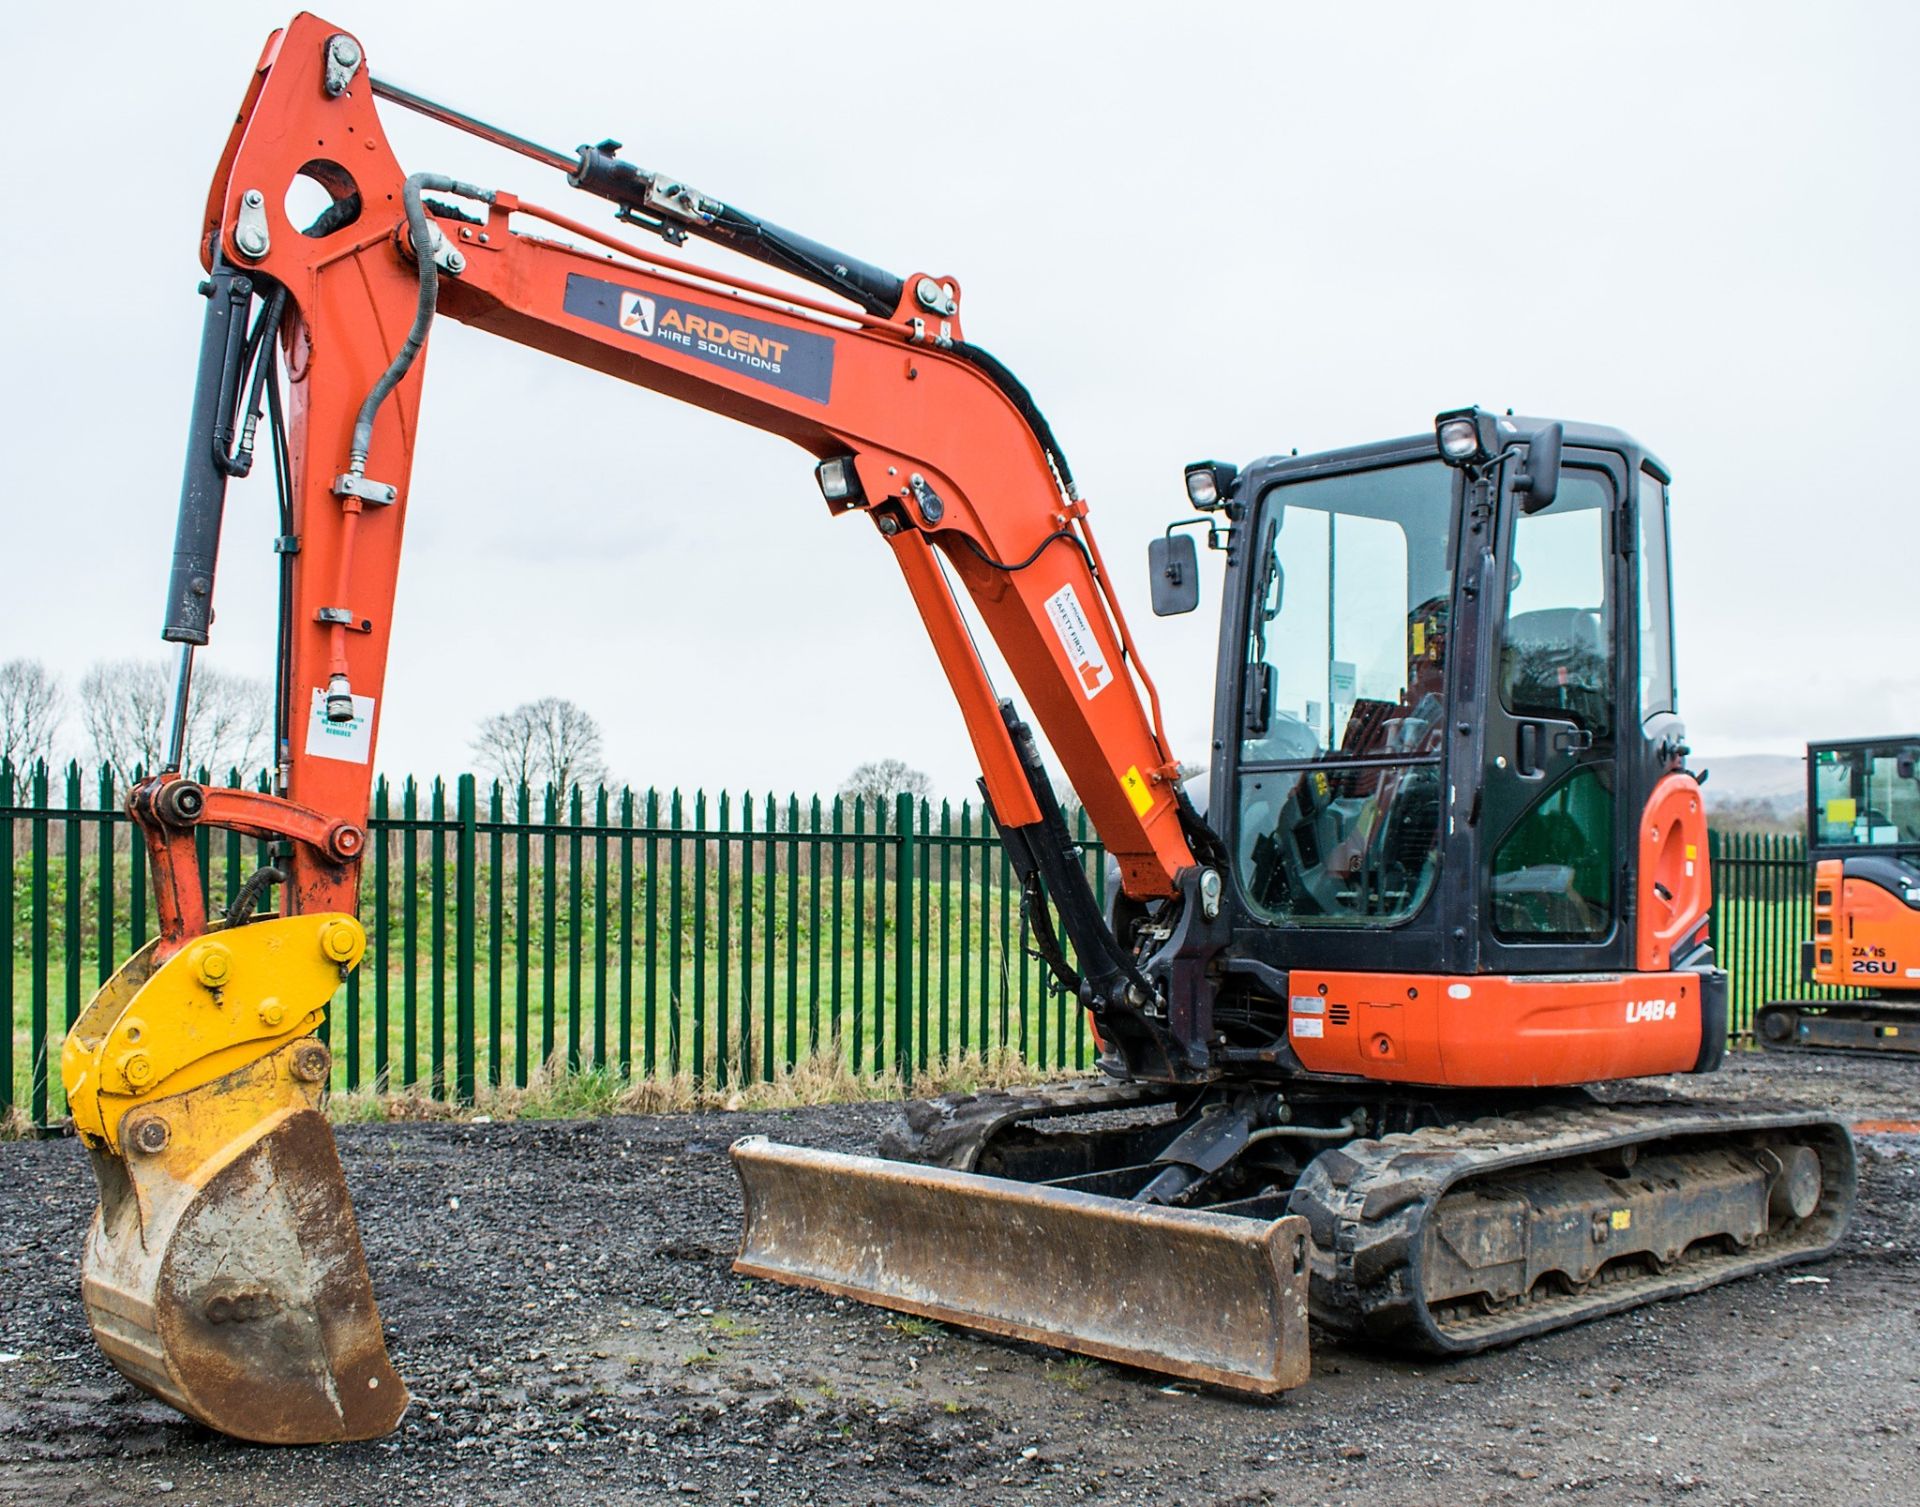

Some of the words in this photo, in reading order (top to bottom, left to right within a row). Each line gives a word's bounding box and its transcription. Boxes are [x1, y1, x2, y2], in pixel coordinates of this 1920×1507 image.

[657, 328, 691, 346] HIRE
[697, 340, 782, 374] SOLUTIONS
[659, 308, 788, 362] ARDENT
[1054, 596, 1073, 630] SAFETY
[1071, 631, 1085, 656] FIRST
[1852, 960, 1897, 975] 26U
